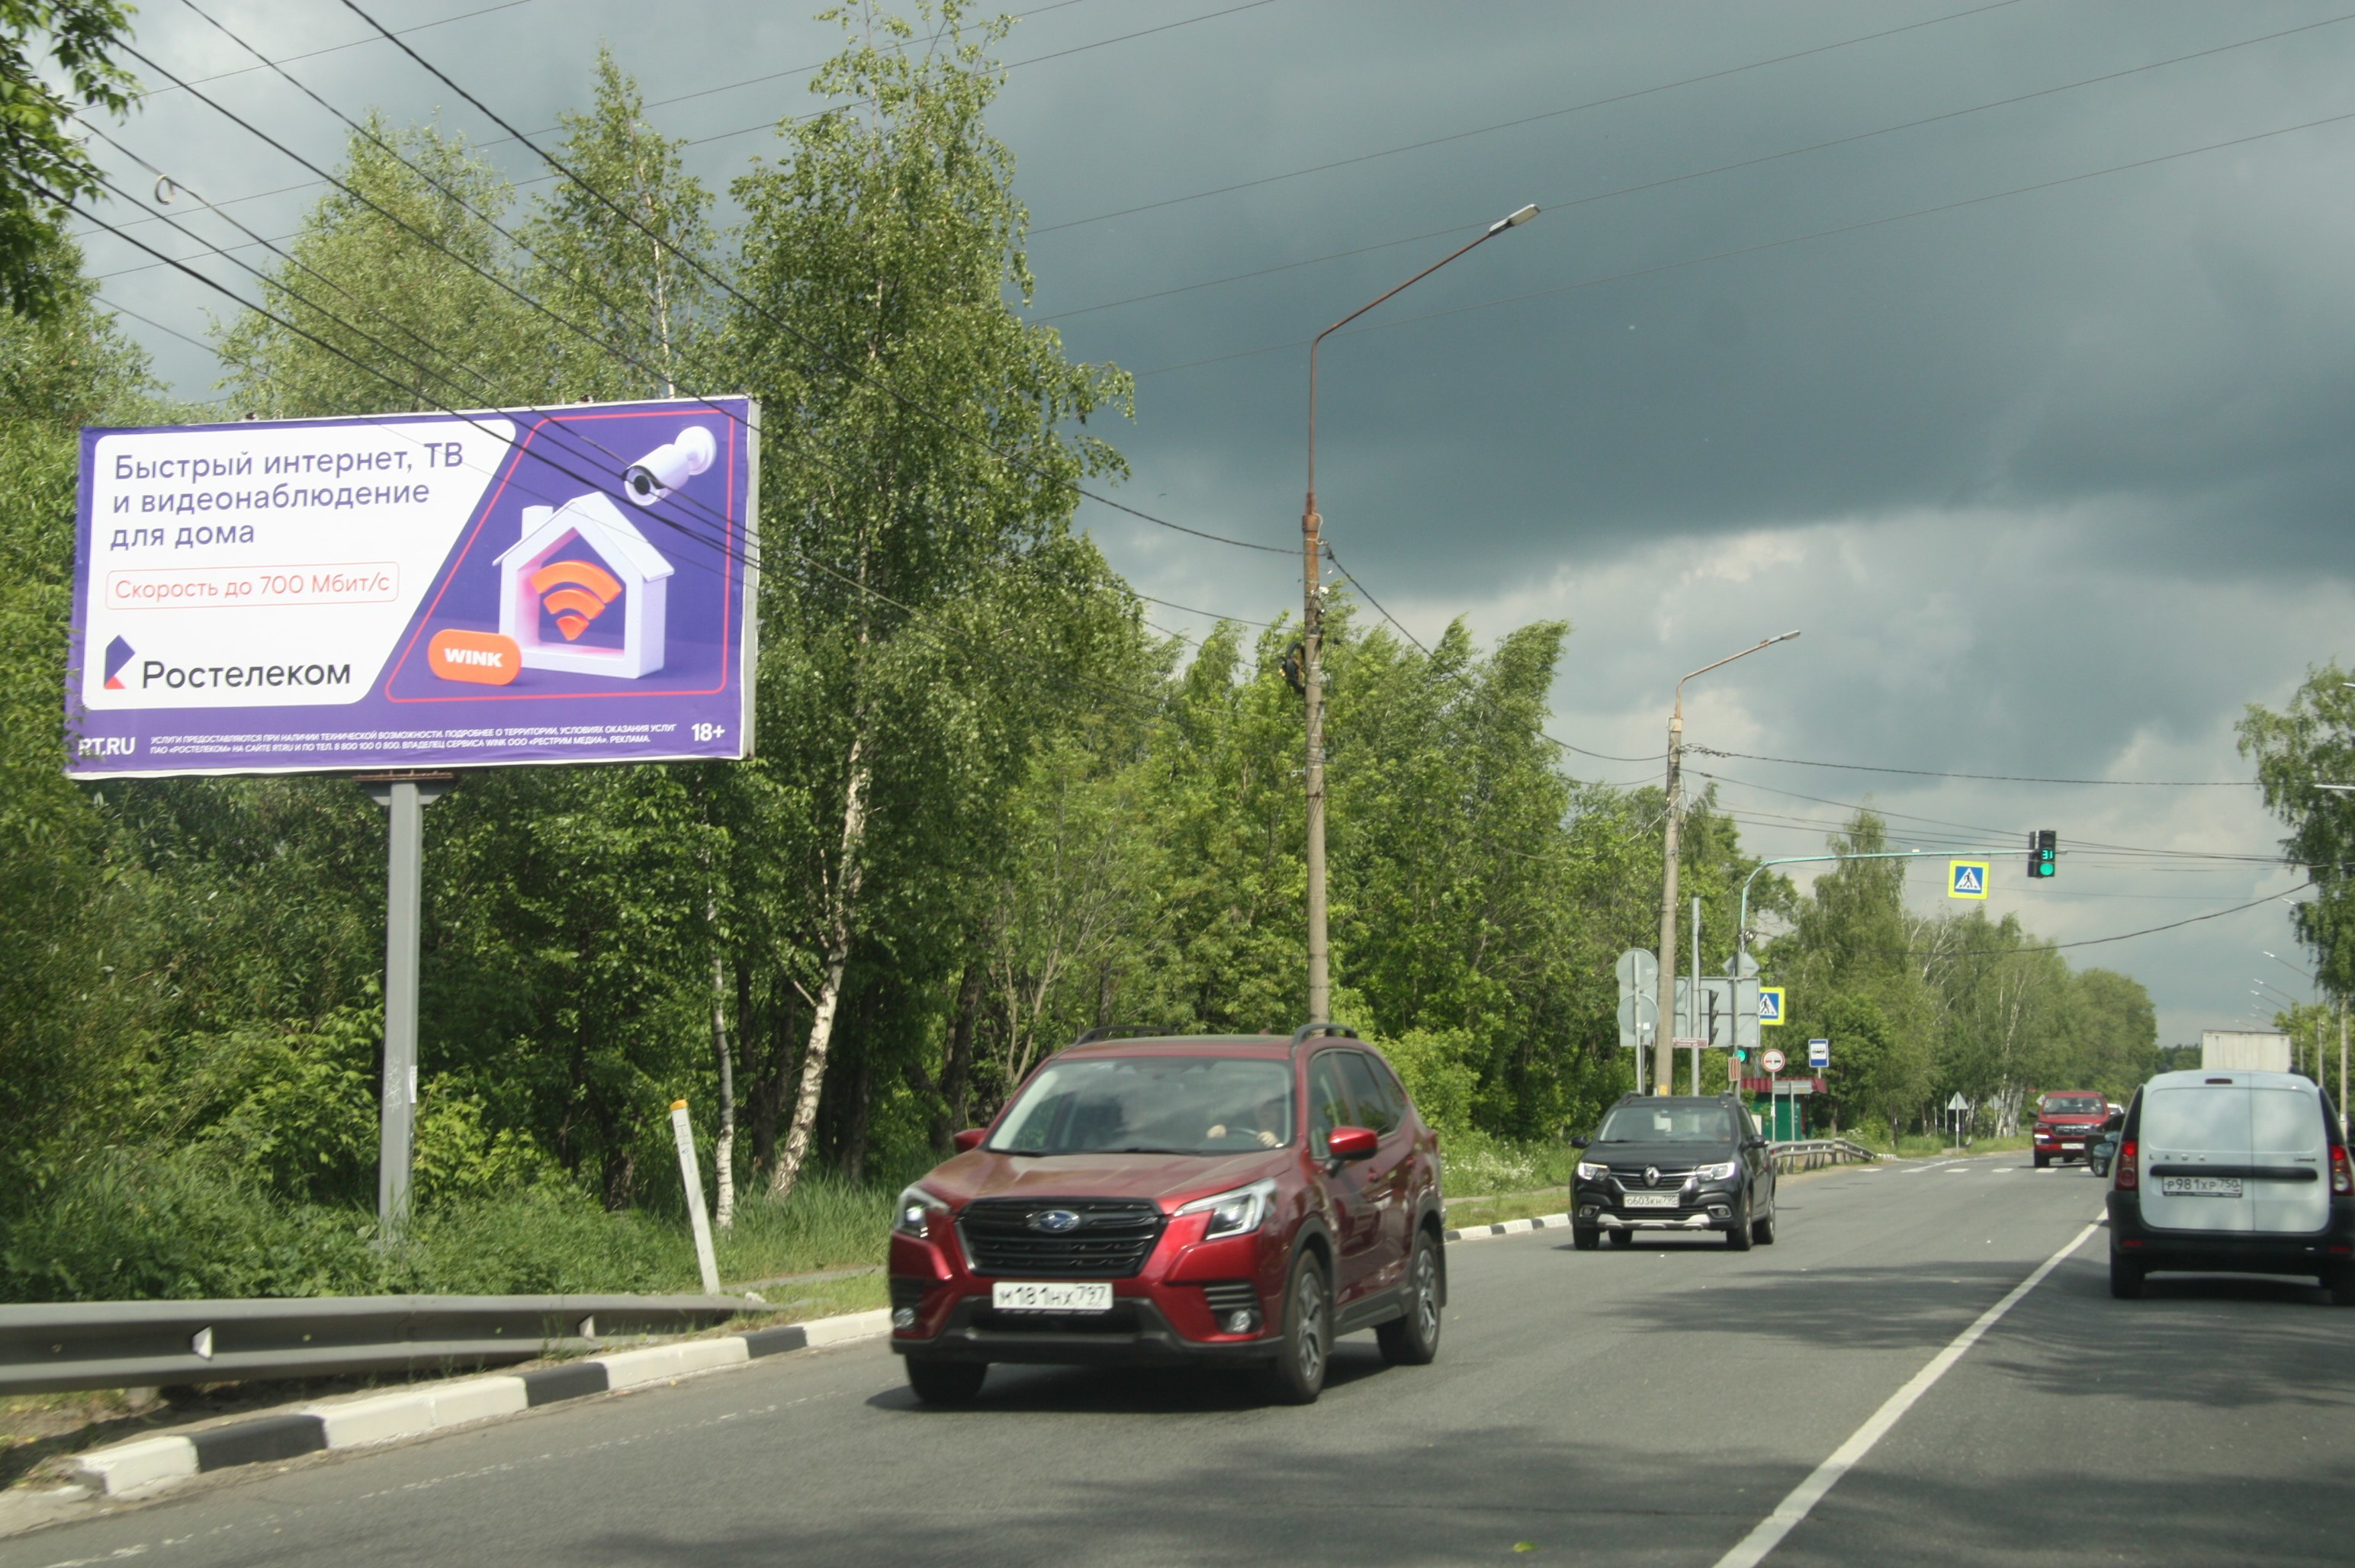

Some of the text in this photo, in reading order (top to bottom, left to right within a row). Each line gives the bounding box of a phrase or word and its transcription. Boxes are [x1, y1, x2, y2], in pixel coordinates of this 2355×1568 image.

[115, 442, 463, 484] Быстрый интернет, ТВ
[114, 483, 429, 516] и видеонаблюдение
[110, 525, 255, 551] для дома
[115, 571, 390, 599] Скорость до 700 Мбит/с
[443, 647, 503, 668] WINK
[143, 660, 350, 689] Ростелеком
[151, 735, 182, 744] УСЛУГИ
[263, 734, 281, 742] ПРИ
[445, 728, 494, 738] ПОДРОБНЕЕ
[605, 725, 649, 734] ОКАЗАНИЯ
[650, 724, 677, 732] УСЛУГ
[691, 723, 725, 741] 18+
[78, 737, 136, 756] RT.RU
[150, 746, 169, 754] ПАО
[232, 744, 244, 753] НА
[245, 743, 271, 752] САЙТЕ
[2042, 850, 2053, 860] 31
